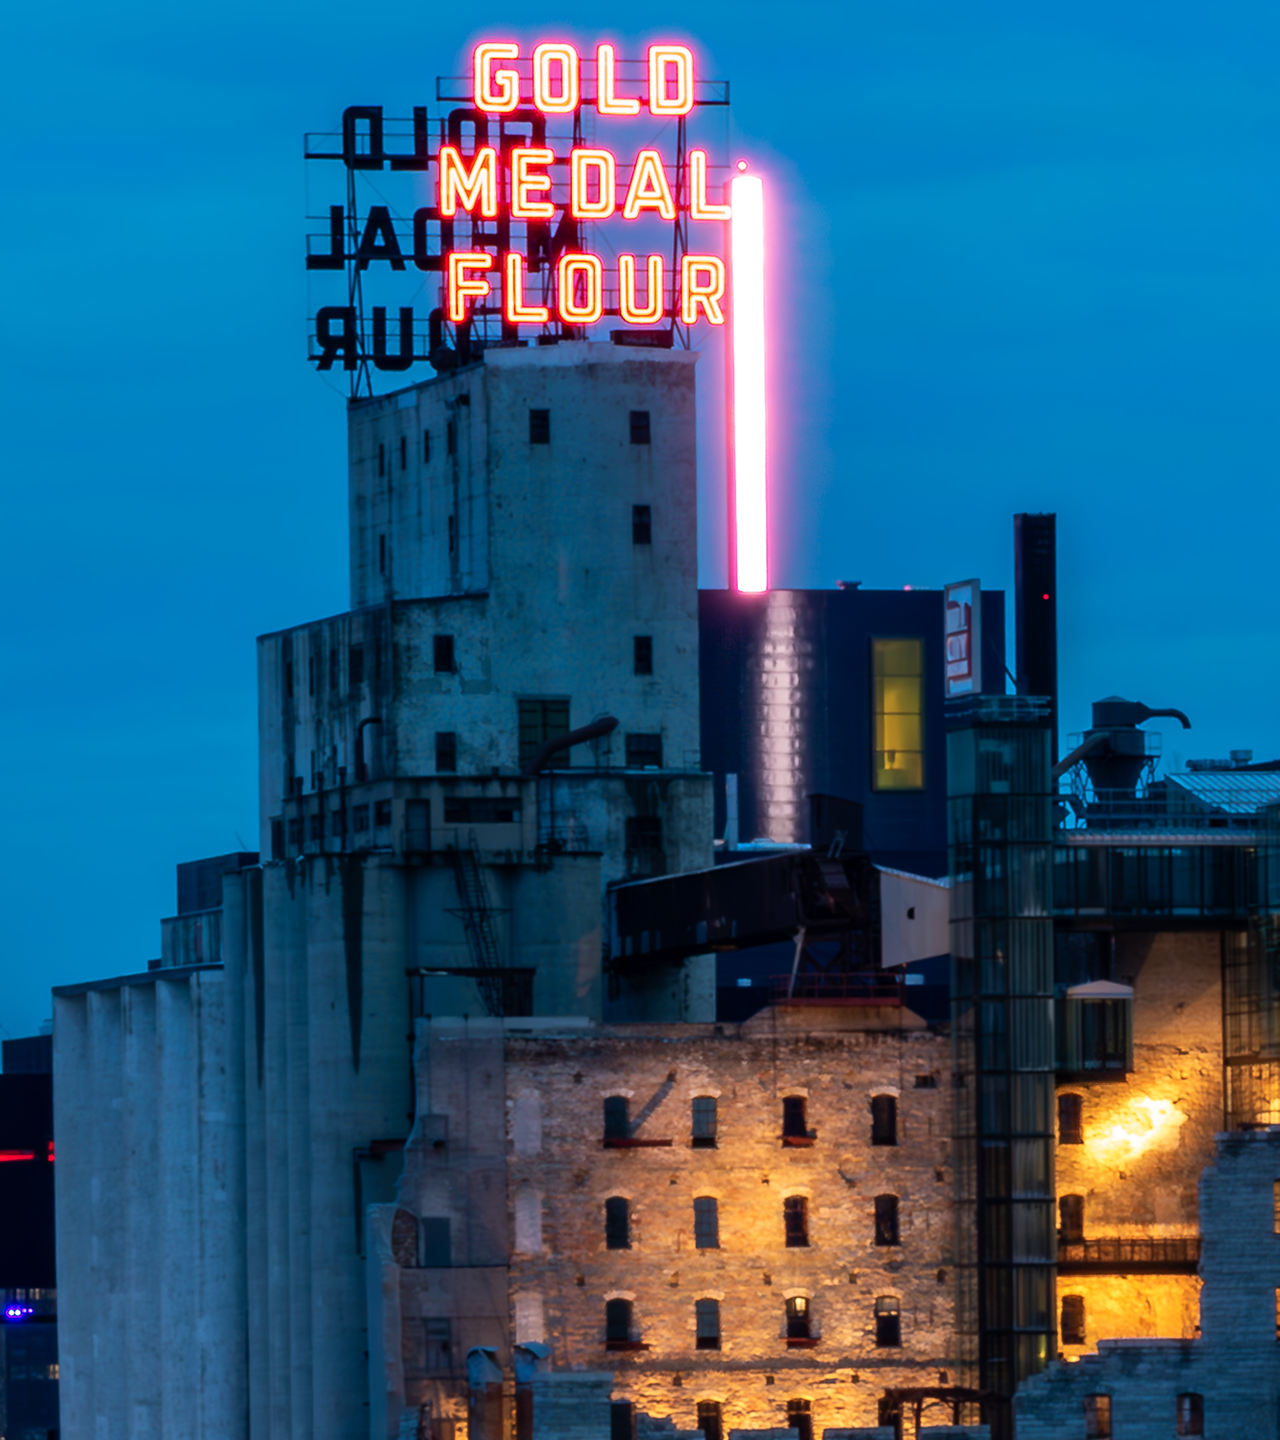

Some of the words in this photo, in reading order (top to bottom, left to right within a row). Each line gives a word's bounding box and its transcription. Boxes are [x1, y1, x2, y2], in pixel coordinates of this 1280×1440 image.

[472, 41, 696, 116] GOLD
[438, 145, 733, 221] MEDAL
[447, 252, 727, 326] FLOUR
